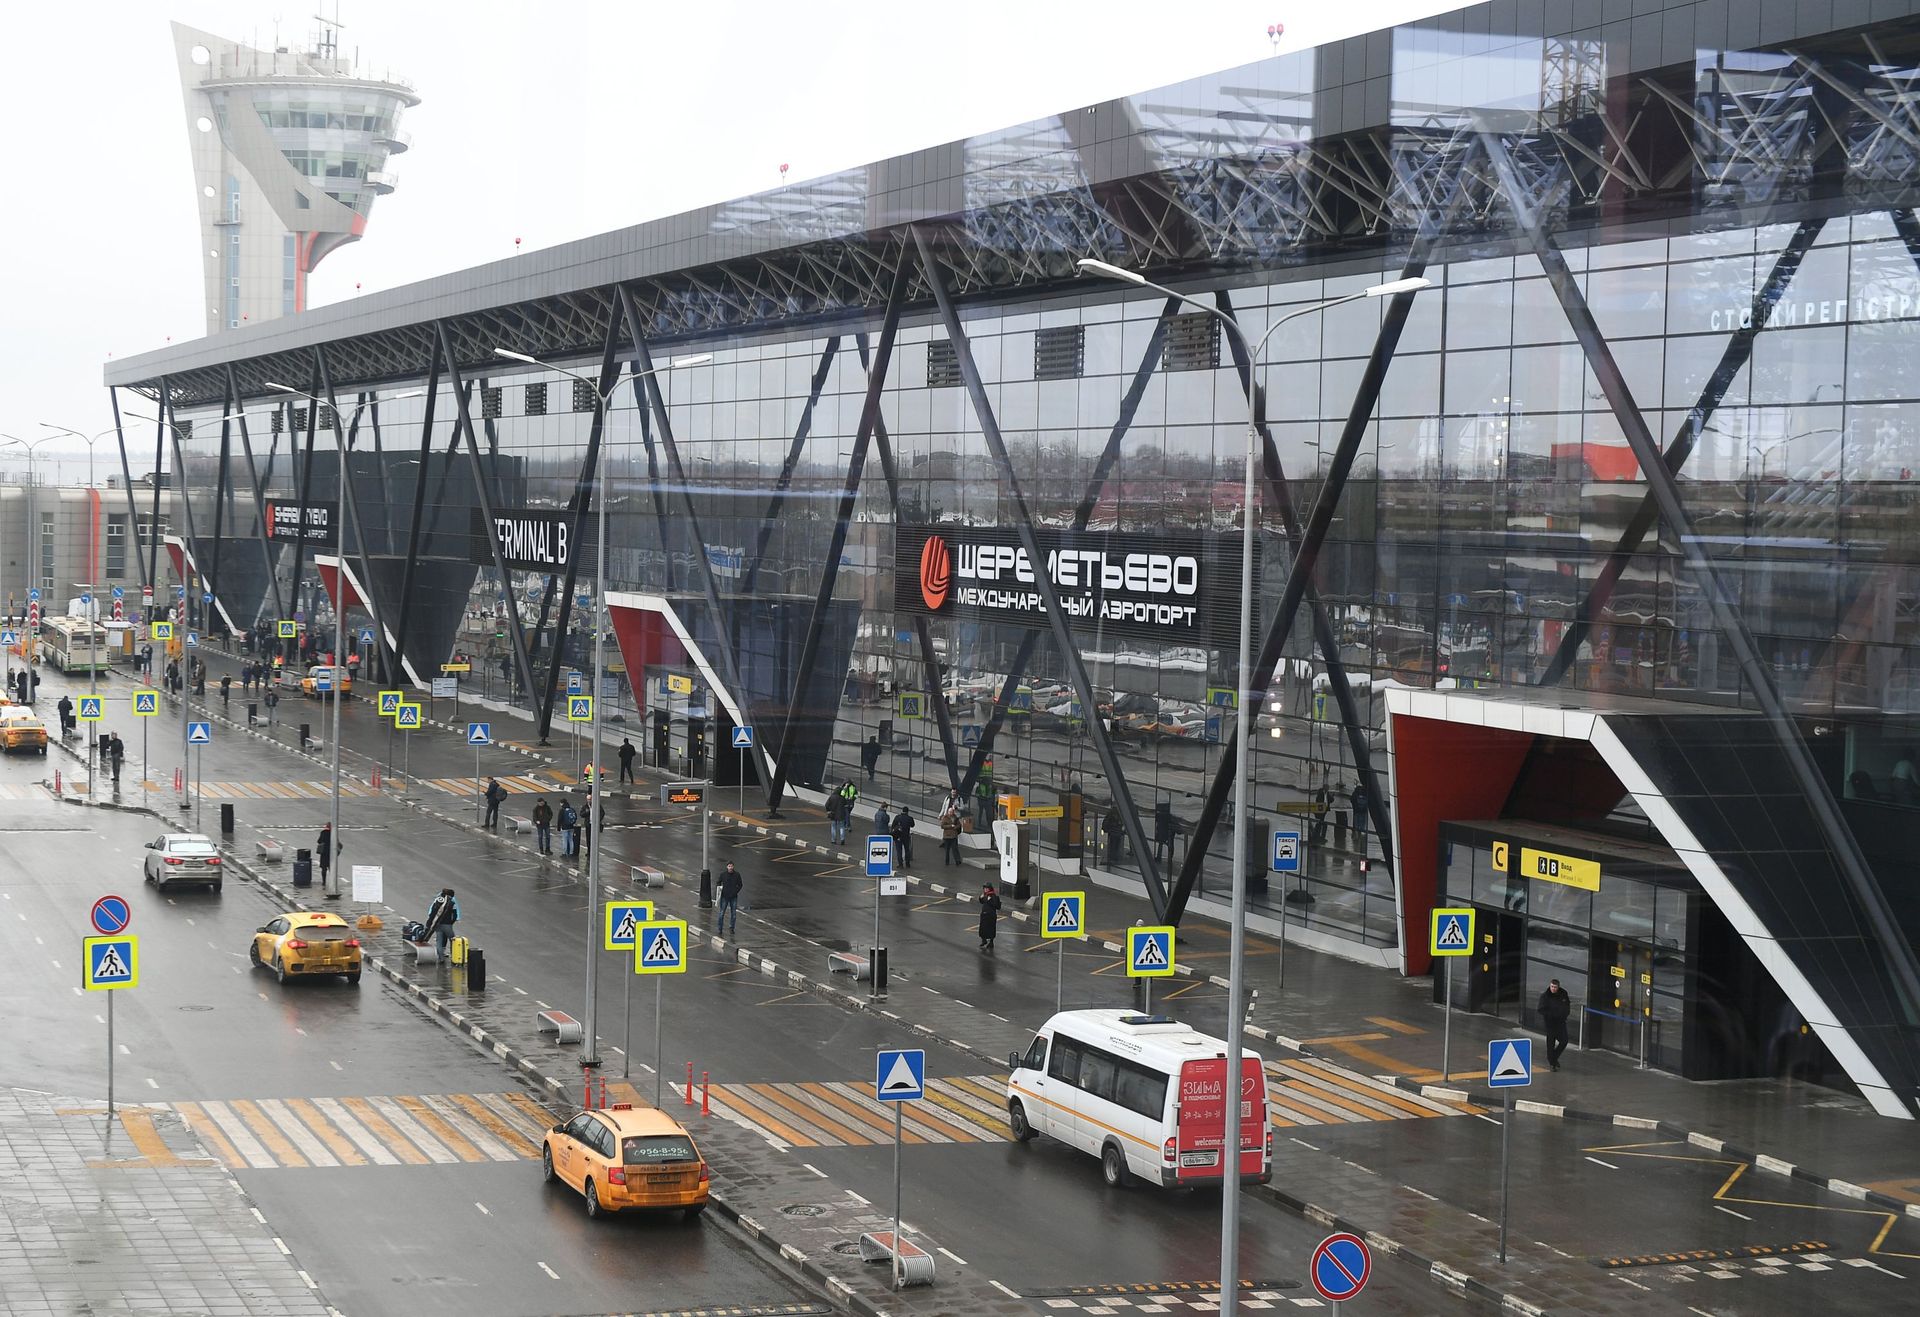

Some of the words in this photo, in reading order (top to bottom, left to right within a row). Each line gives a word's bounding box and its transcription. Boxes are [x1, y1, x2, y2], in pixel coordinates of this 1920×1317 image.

[492, 518, 554, 563] ERMINAL
[558, 522, 567, 564] B
[1100, 600, 1197, 627] АЭРОПОРТ
[1550, 861, 1557, 874] B
